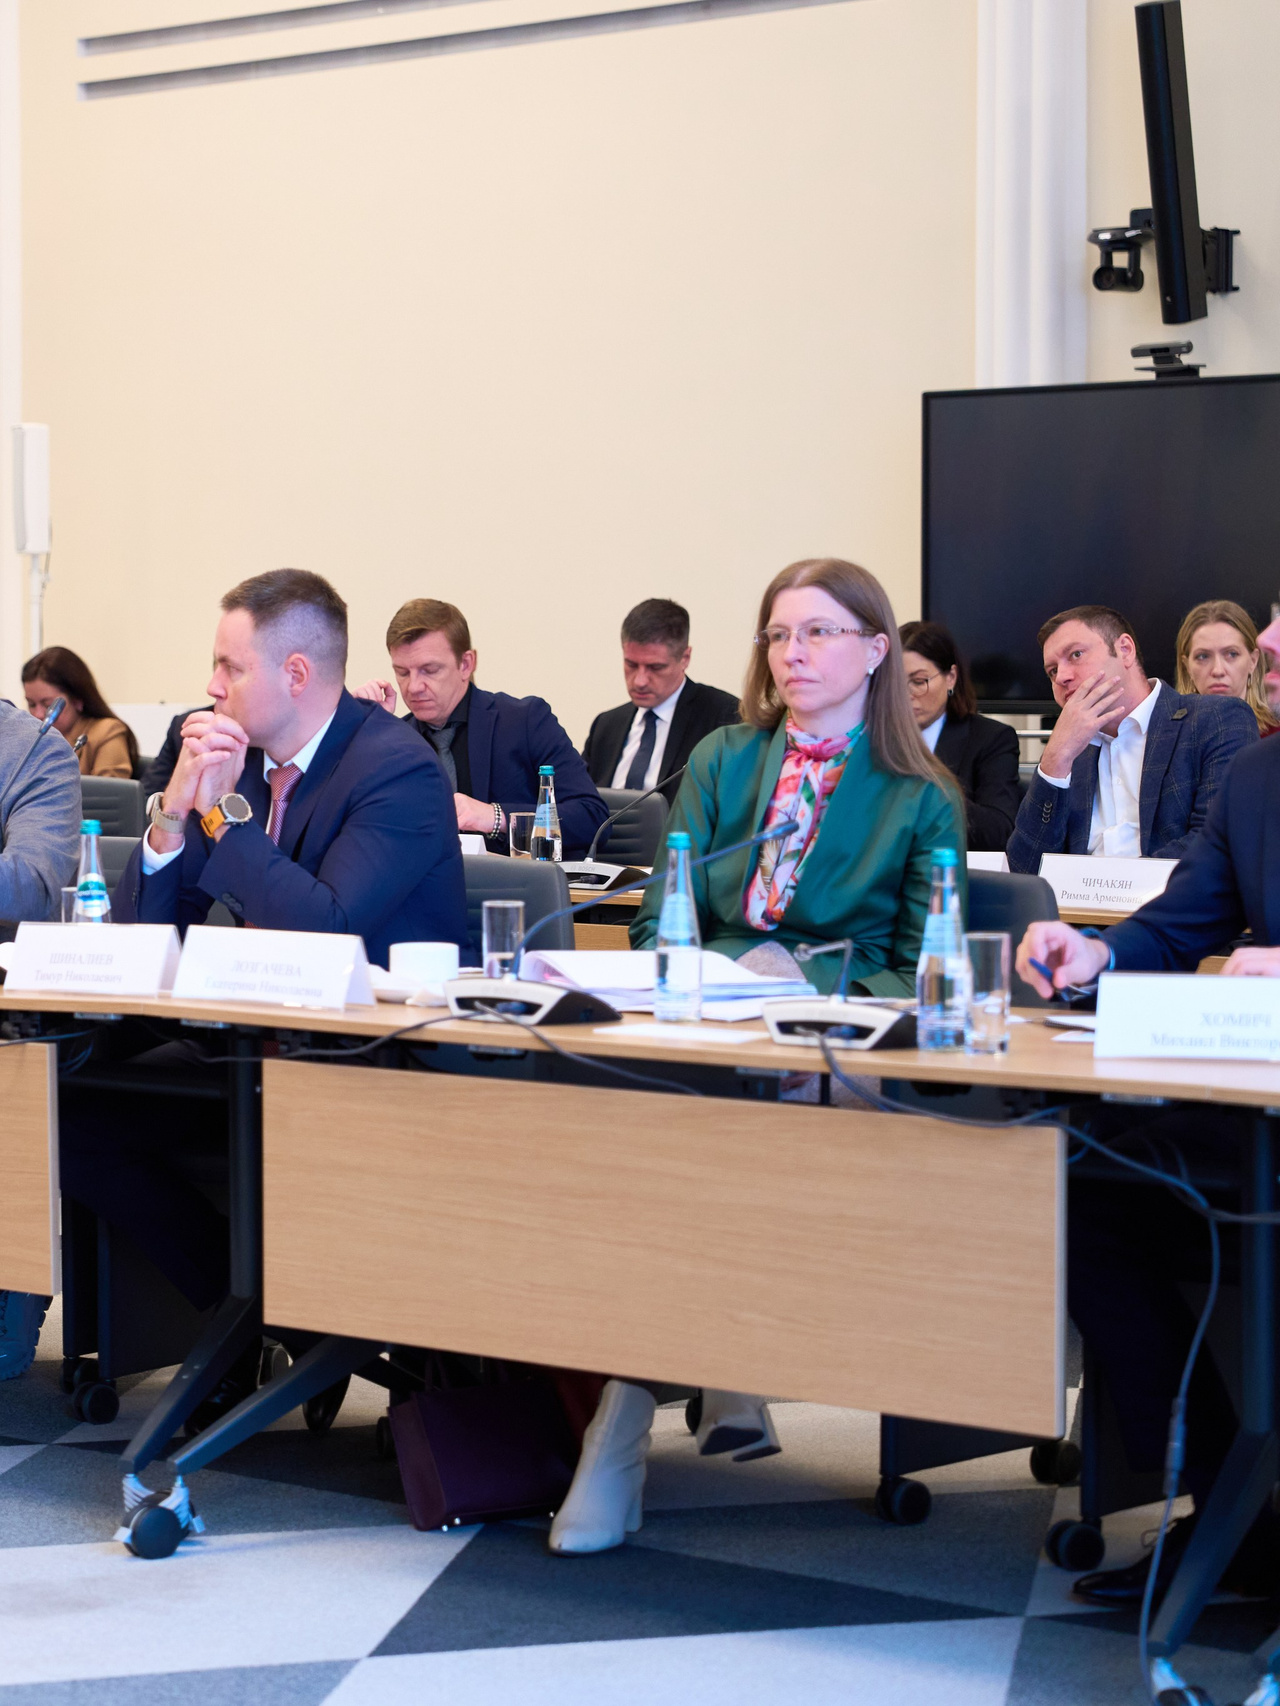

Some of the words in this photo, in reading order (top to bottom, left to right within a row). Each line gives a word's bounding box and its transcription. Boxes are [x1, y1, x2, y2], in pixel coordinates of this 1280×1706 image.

[1082, 877, 1133, 890] ЧИЧАКЯН
[1061, 890, 1090, 901] Римма
[1092, 892, 1143, 905] Арменовна
[49, 953, 114, 966] ШИНАЛИЕВ
[34, 970, 63, 984] Тимур
[64, 970, 122, 984] Николаевич
[204, 977, 257, 994] Екатерина
[259, 979, 323, 997] Николаевна
[1220, 1033, 1280, 1053] Виктор
